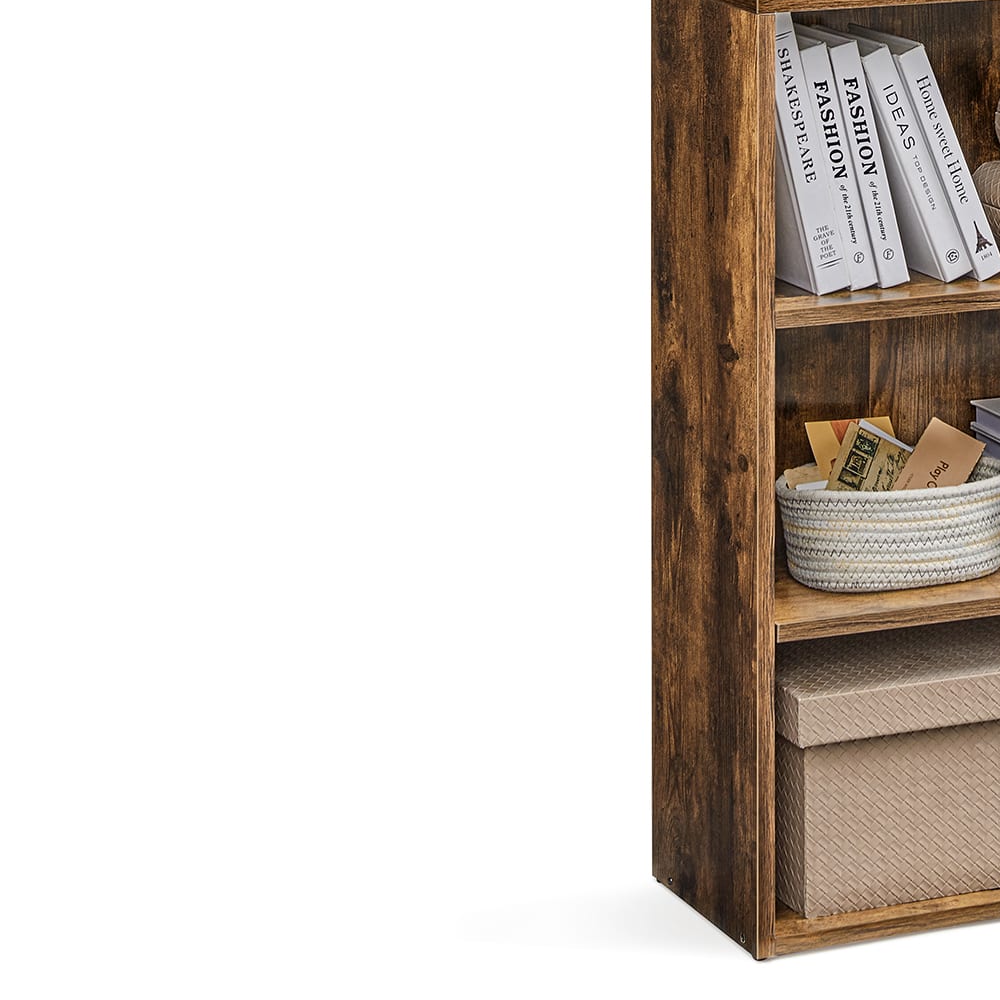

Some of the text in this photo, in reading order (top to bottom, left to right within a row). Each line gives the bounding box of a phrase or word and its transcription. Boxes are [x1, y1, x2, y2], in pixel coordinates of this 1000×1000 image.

[777, 47, 817, 183] SHAKESPEARE
[813, 80, 848, 179] FASHION
[843, 77, 878, 175] FASHION
[883, 84, 937, 211] IDEAS TOP DESIGN
[916, 75, 969, 205] Home sweet Home
[839, 184, 848, 192] of
[869, 181, 878, 189] of
[841, 193, 849, 204] the
[871, 190, 879, 200] the
[812, 230, 836, 242] GRAVE
[816, 224, 829, 234] THE
[847, 219, 858, 244] century
[877, 216, 887, 241] century
[819, 250, 837, 260] POET
[820, 244, 834, 253] THE
[929, 460, 949, 480] Play
